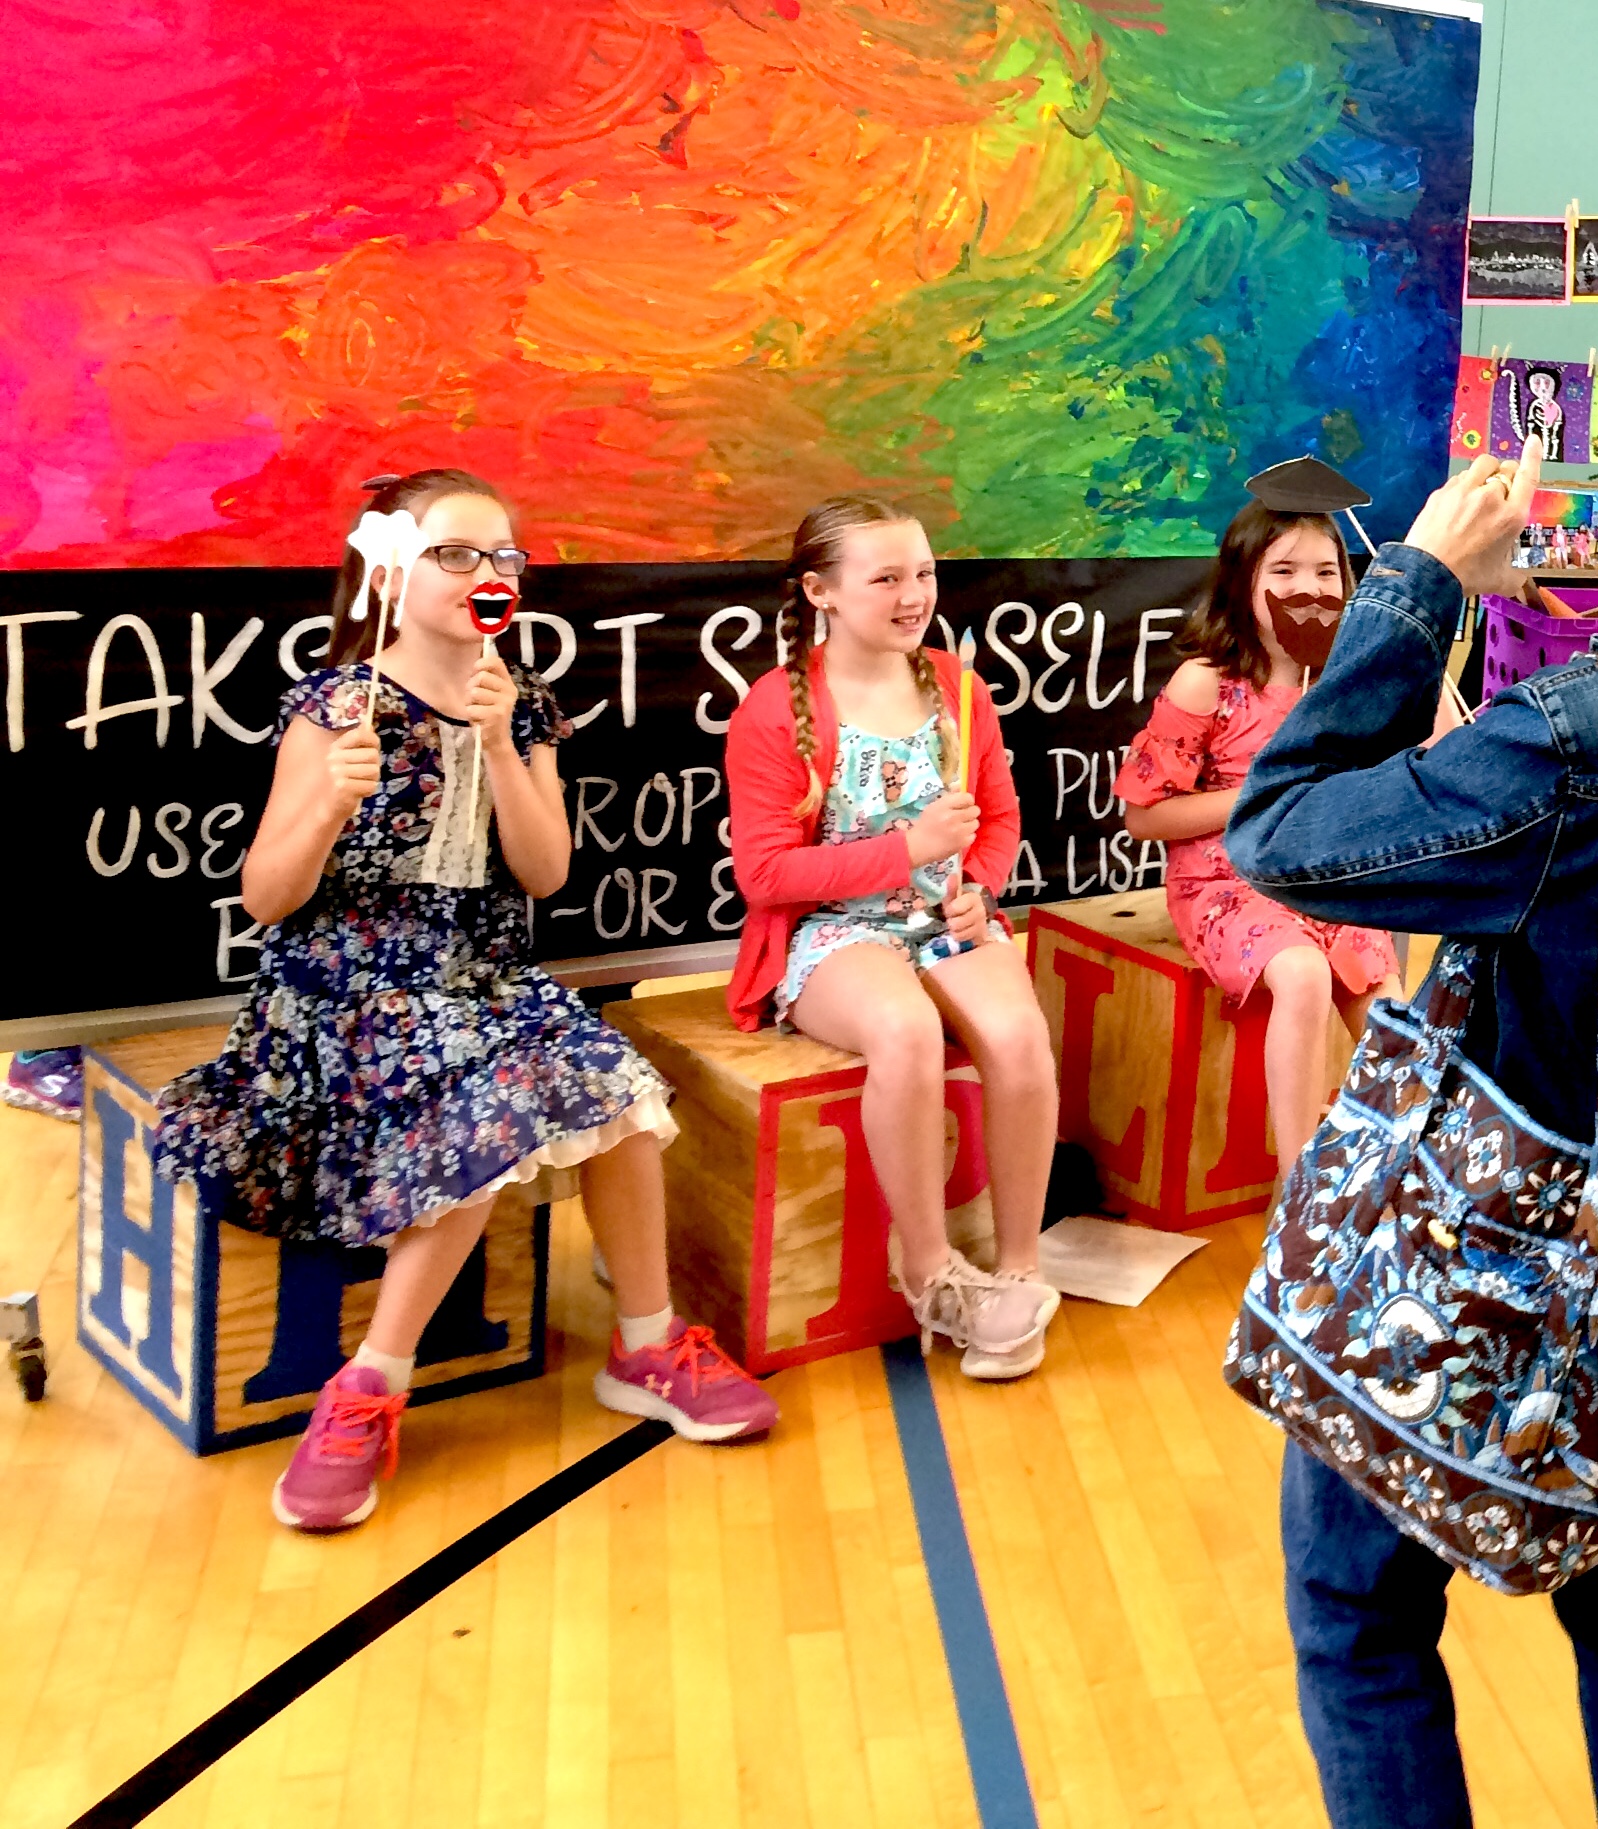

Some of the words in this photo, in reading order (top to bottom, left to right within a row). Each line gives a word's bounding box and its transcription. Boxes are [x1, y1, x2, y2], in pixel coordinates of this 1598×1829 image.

[511, 611, 665, 729] RT
[940, 602, 1185, 716] SELF
[86, 802, 247, 879] USE
[560, 767, 732, 853] ROP
[1067, 829, 1168, 895] LISA
